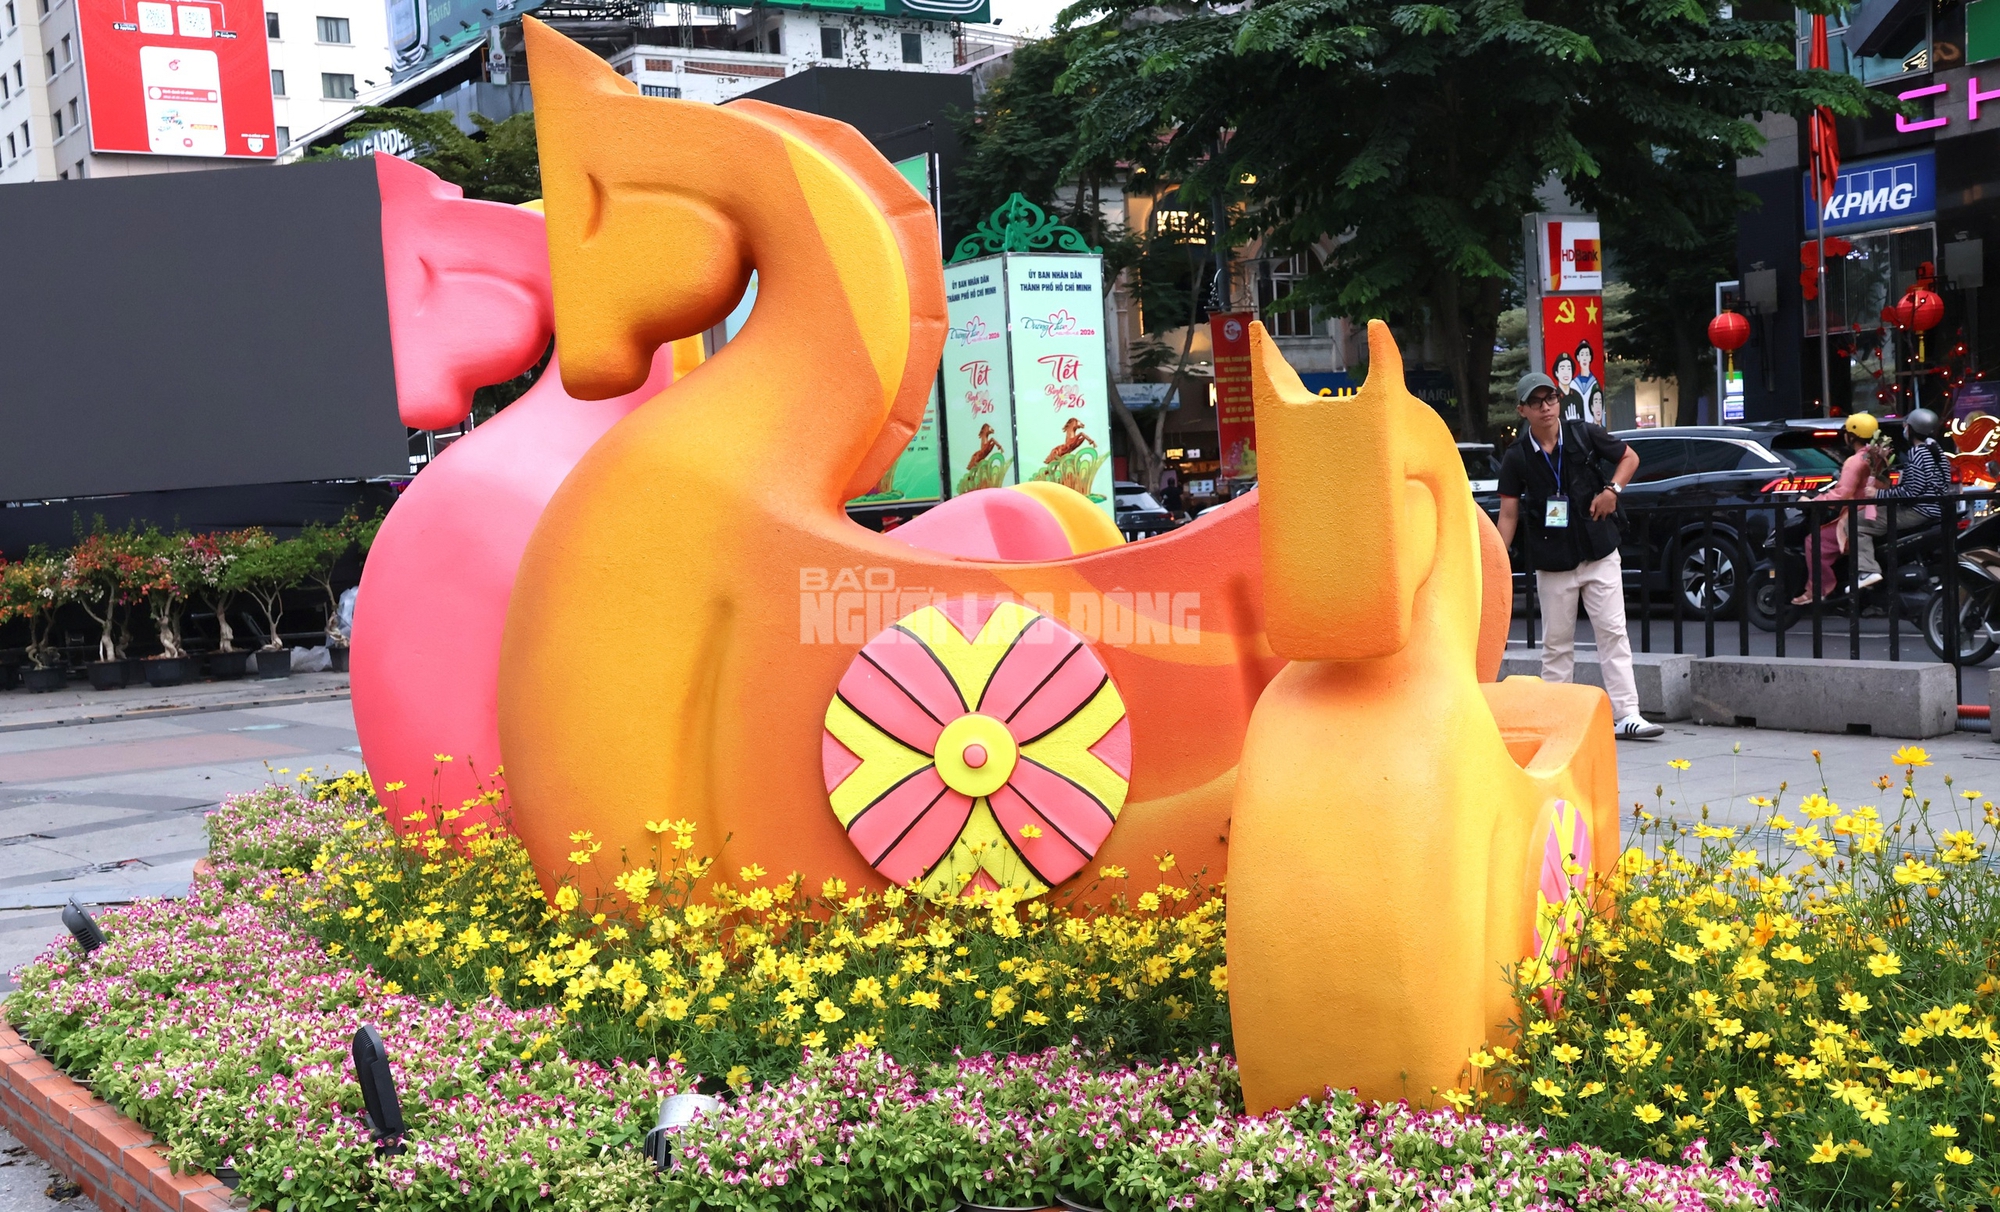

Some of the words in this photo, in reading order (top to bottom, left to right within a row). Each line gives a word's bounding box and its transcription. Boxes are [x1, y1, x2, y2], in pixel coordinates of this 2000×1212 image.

[1823, 182, 1914, 220] KPMG
[1562, 249, 1598, 262] HDBank
[1029, 270, 1036, 278] ỦY
[1052, 270, 1069, 278] NHÂN
[1070, 270, 1082, 278] DÂN
[1020, 282, 1040, 291] THÀNH
[1041, 281, 1054, 291] PHỐ
[1055, 281, 1063, 291] HỒ
[1064, 282, 1075, 291] CHÍ
[960, 361, 992, 389] Tết
[1037, 354, 1083, 383] Tết
[981, 398, 994, 414] 26
[1067, 393, 1085, 408] 26
